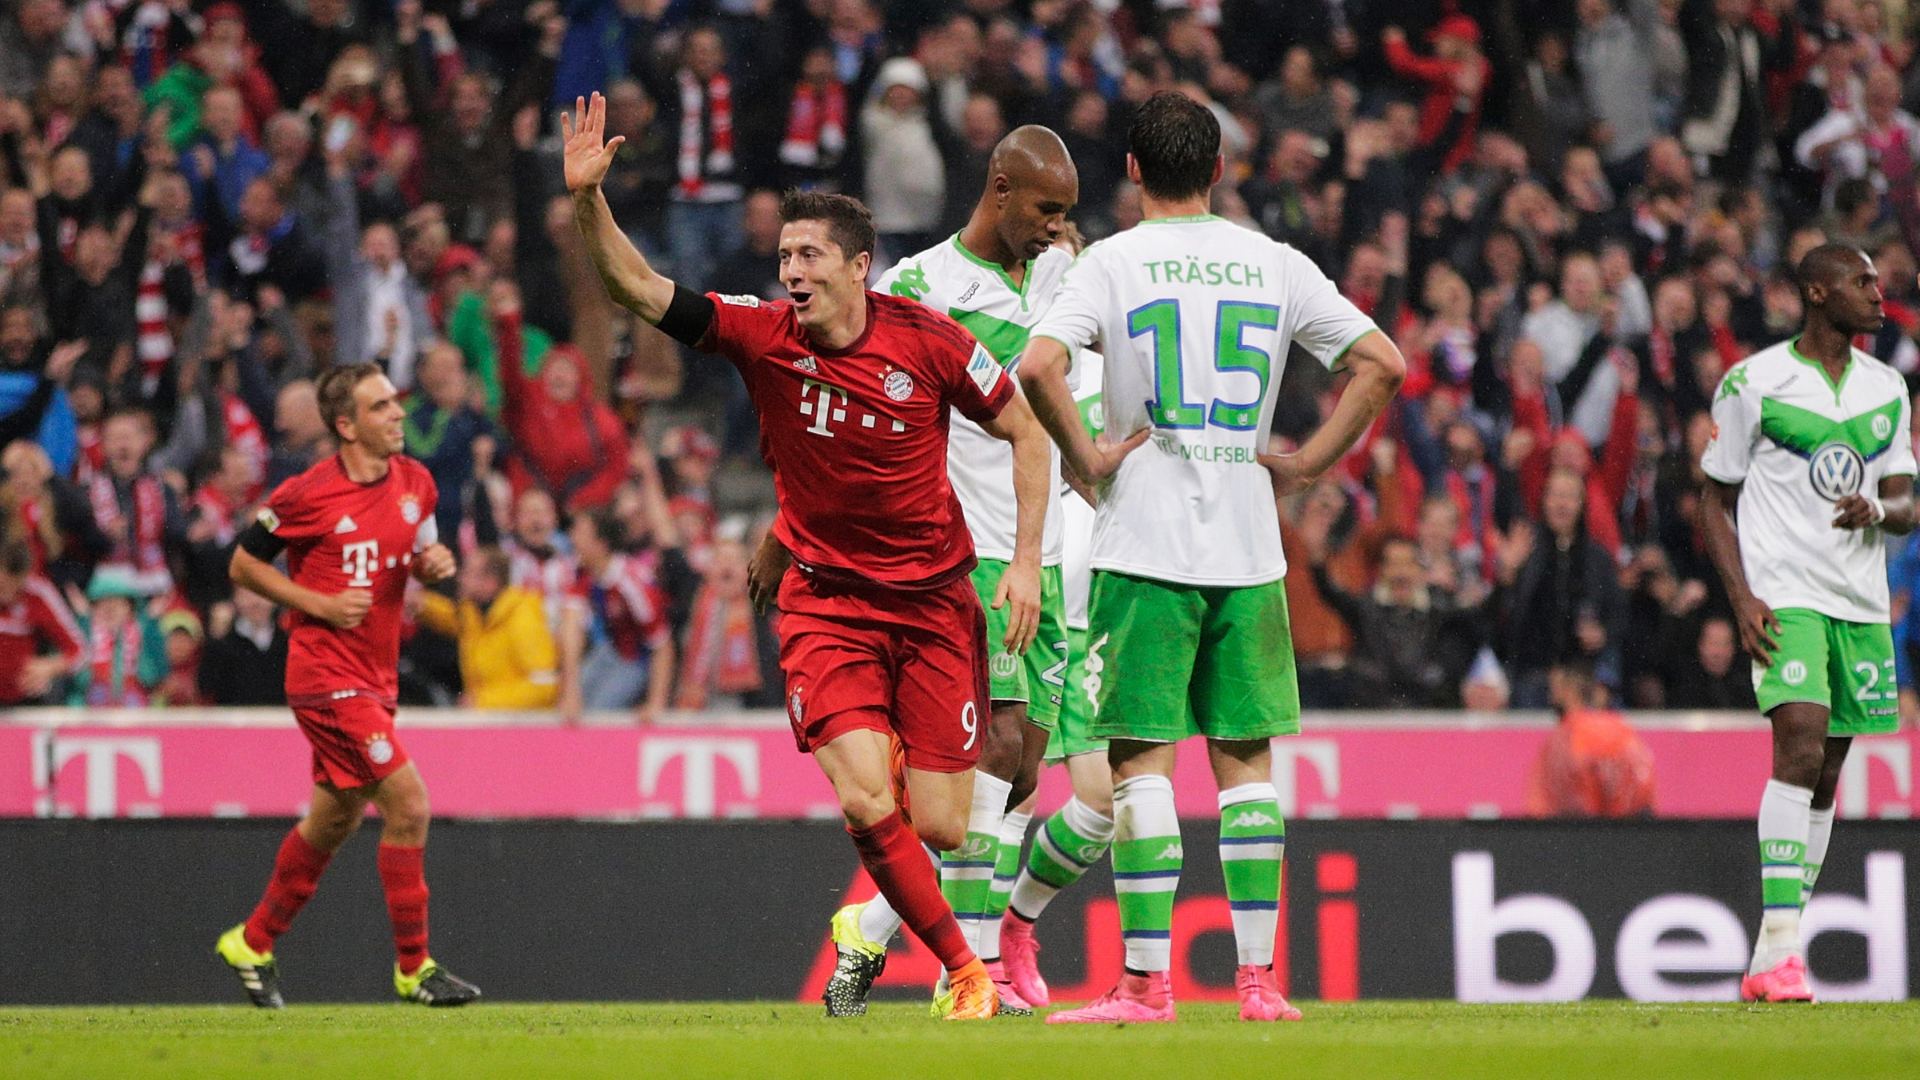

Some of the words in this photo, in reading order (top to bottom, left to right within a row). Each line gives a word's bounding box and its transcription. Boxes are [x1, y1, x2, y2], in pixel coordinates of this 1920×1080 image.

[1143, 255, 1264, 288] TRÄSCH
[1127, 298, 1280, 431] 15
[961, 701, 977, 751] 9
[1452, 850, 1909, 1003] bed
